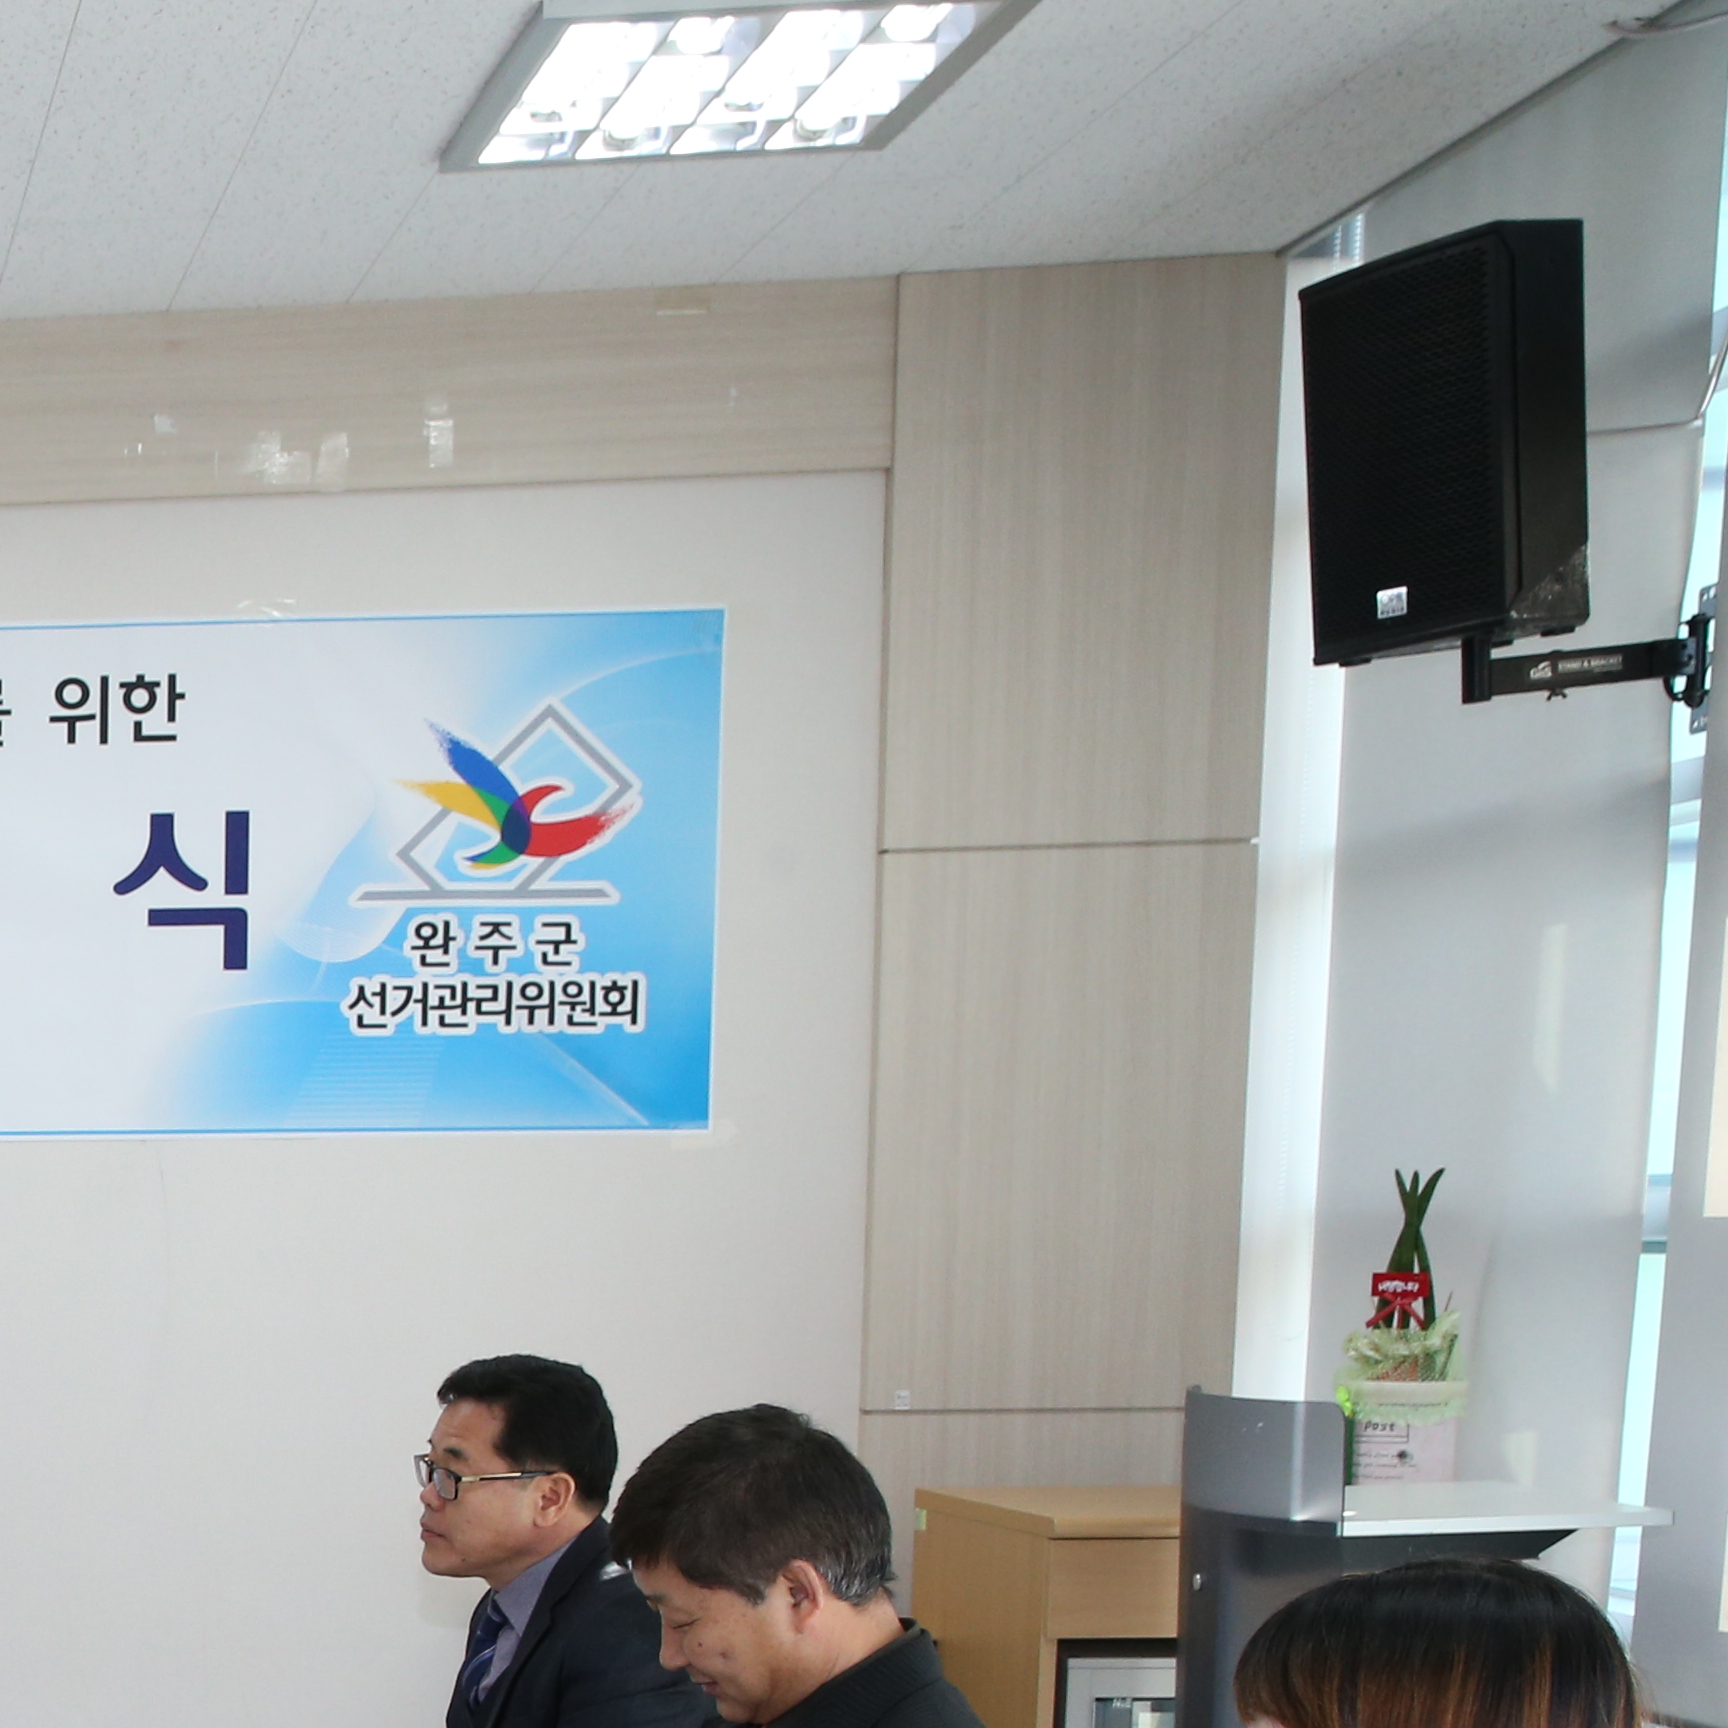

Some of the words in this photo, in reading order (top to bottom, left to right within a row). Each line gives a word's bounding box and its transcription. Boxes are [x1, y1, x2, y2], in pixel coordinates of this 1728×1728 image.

[48, 673, 187, 745] 위한
[410, 920, 579, 967] 완주군
[348, 979, 640, 1028] 선거관리위원회
